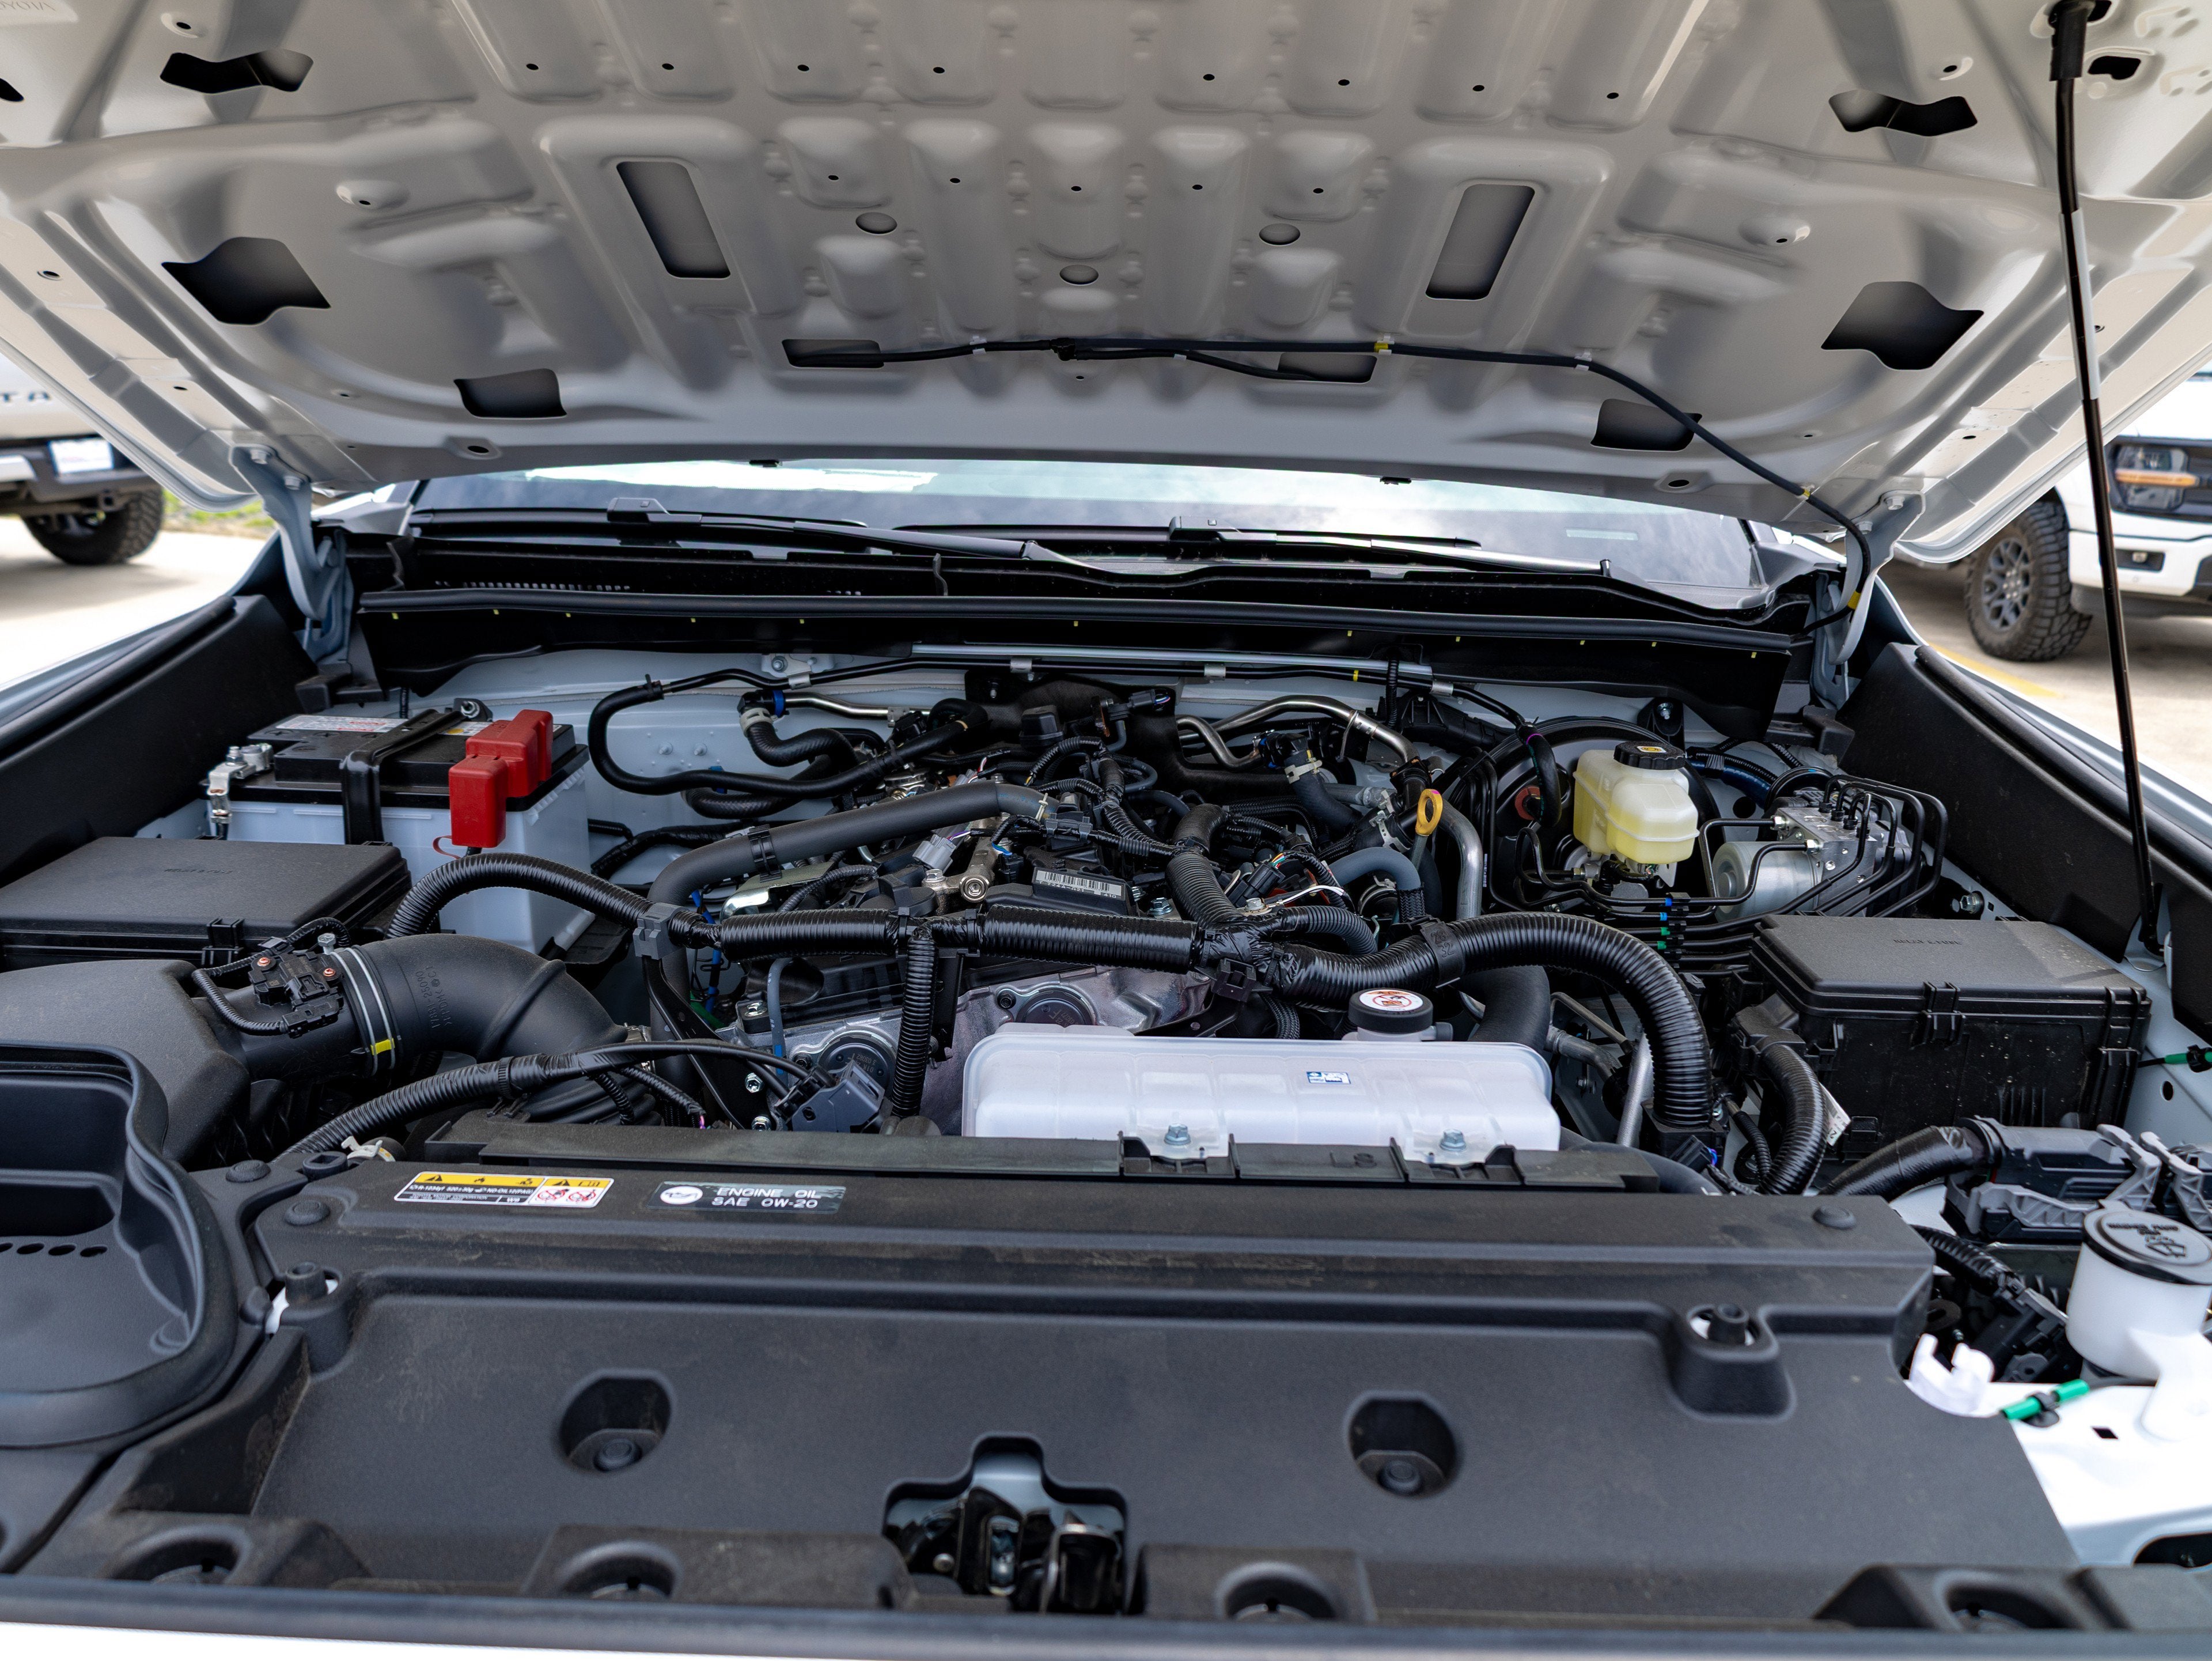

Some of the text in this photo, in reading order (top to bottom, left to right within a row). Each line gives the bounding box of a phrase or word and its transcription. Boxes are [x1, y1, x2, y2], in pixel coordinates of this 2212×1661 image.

[1438, 942, 1455, 958] 32
[716, 1187, 822, 1199] ENGINE OIL
[711, 1197, 819, 1209] SAE 0W-20
